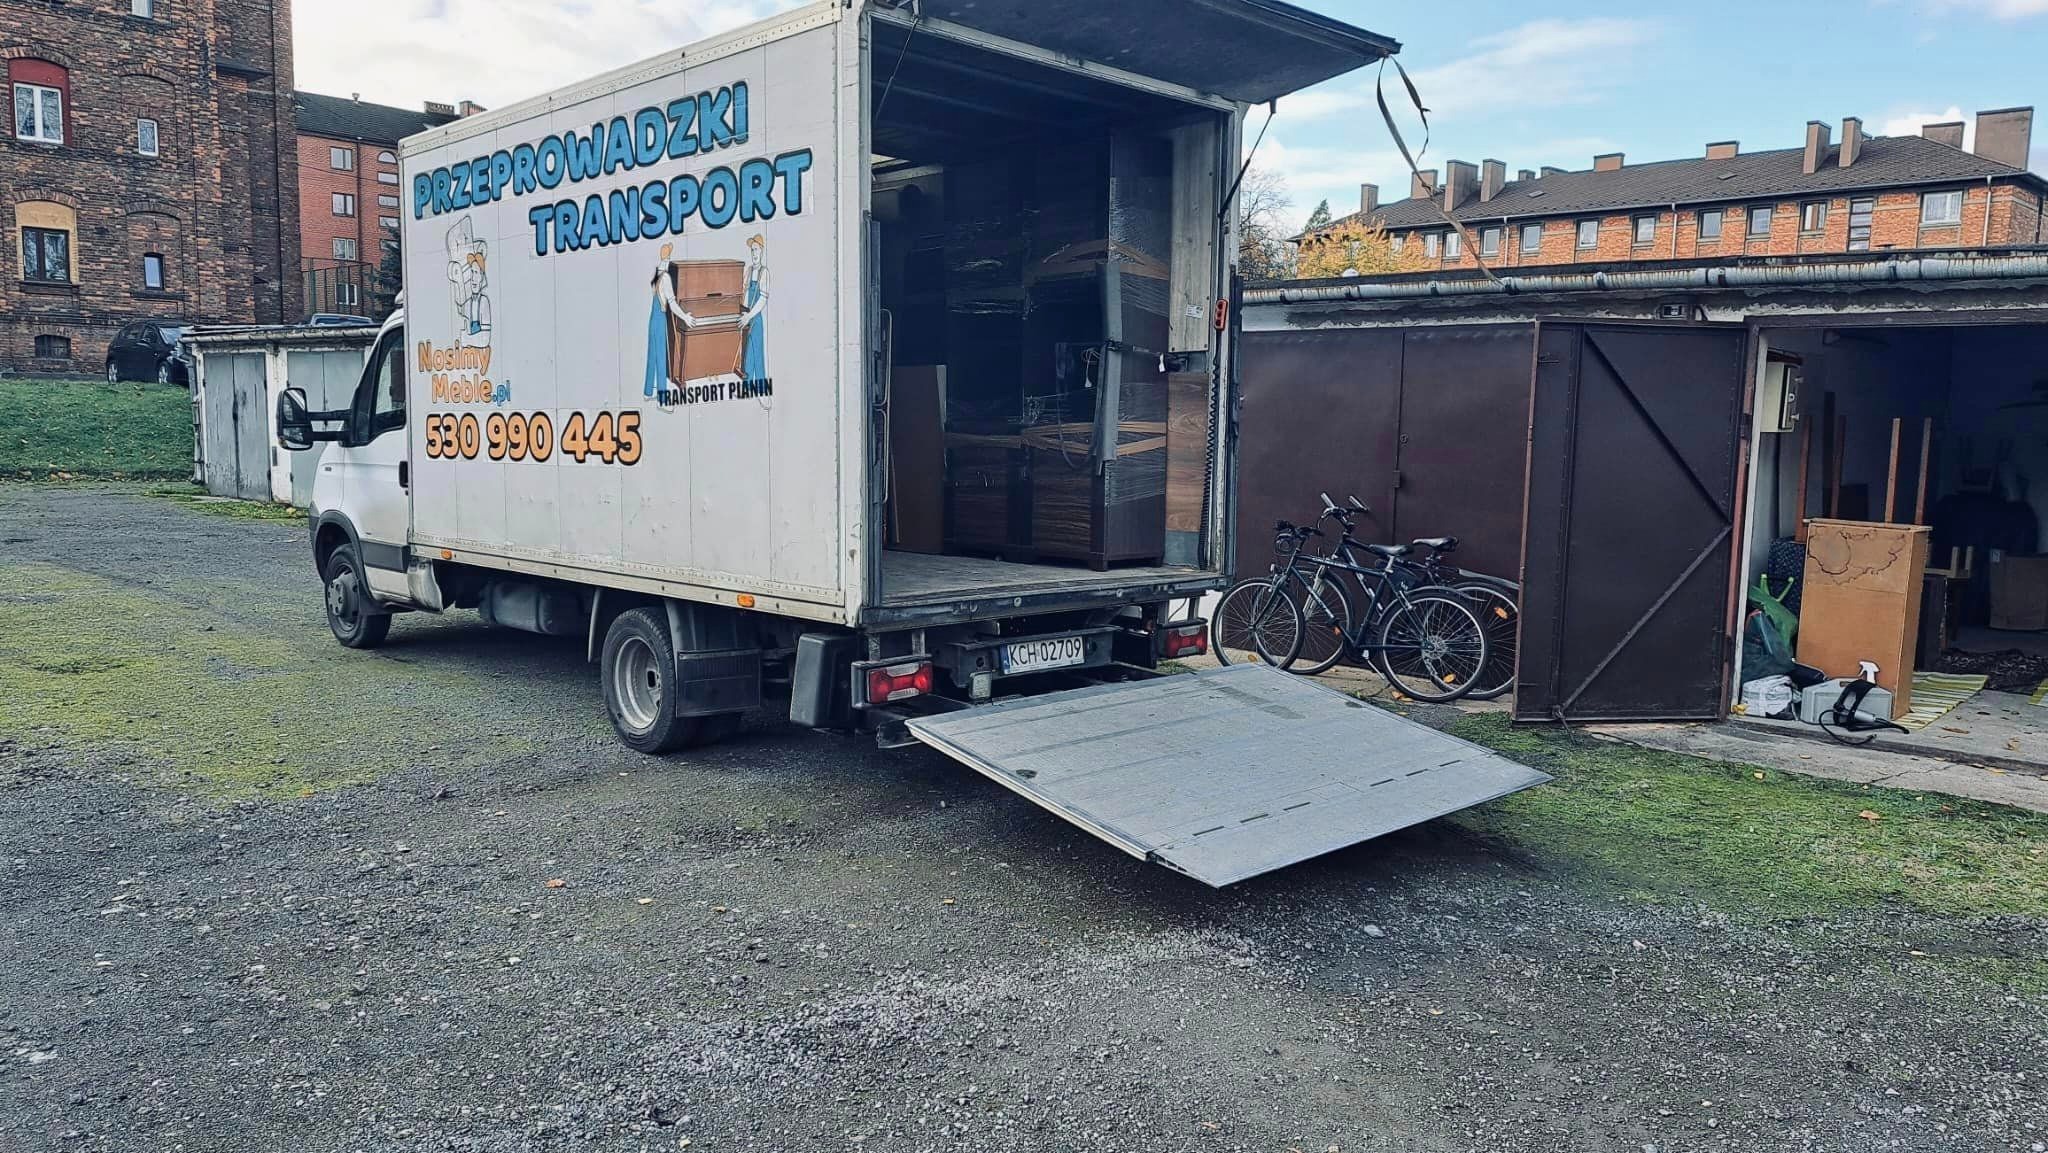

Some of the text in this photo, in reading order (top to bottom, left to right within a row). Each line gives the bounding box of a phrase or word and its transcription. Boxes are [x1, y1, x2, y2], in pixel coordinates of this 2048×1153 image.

[413, 81, 749, 219] PRZEPROWADZKI
[529, 148, 813, 256] TRANSPORT
[418, 339, 491, 375] Nosimy
[657, 378, 773, 407] TRANSPORT PIANIN
[426, 411, 642, 465] 530 990 445
[1009, 638, 1081, 666] KCH 02709
